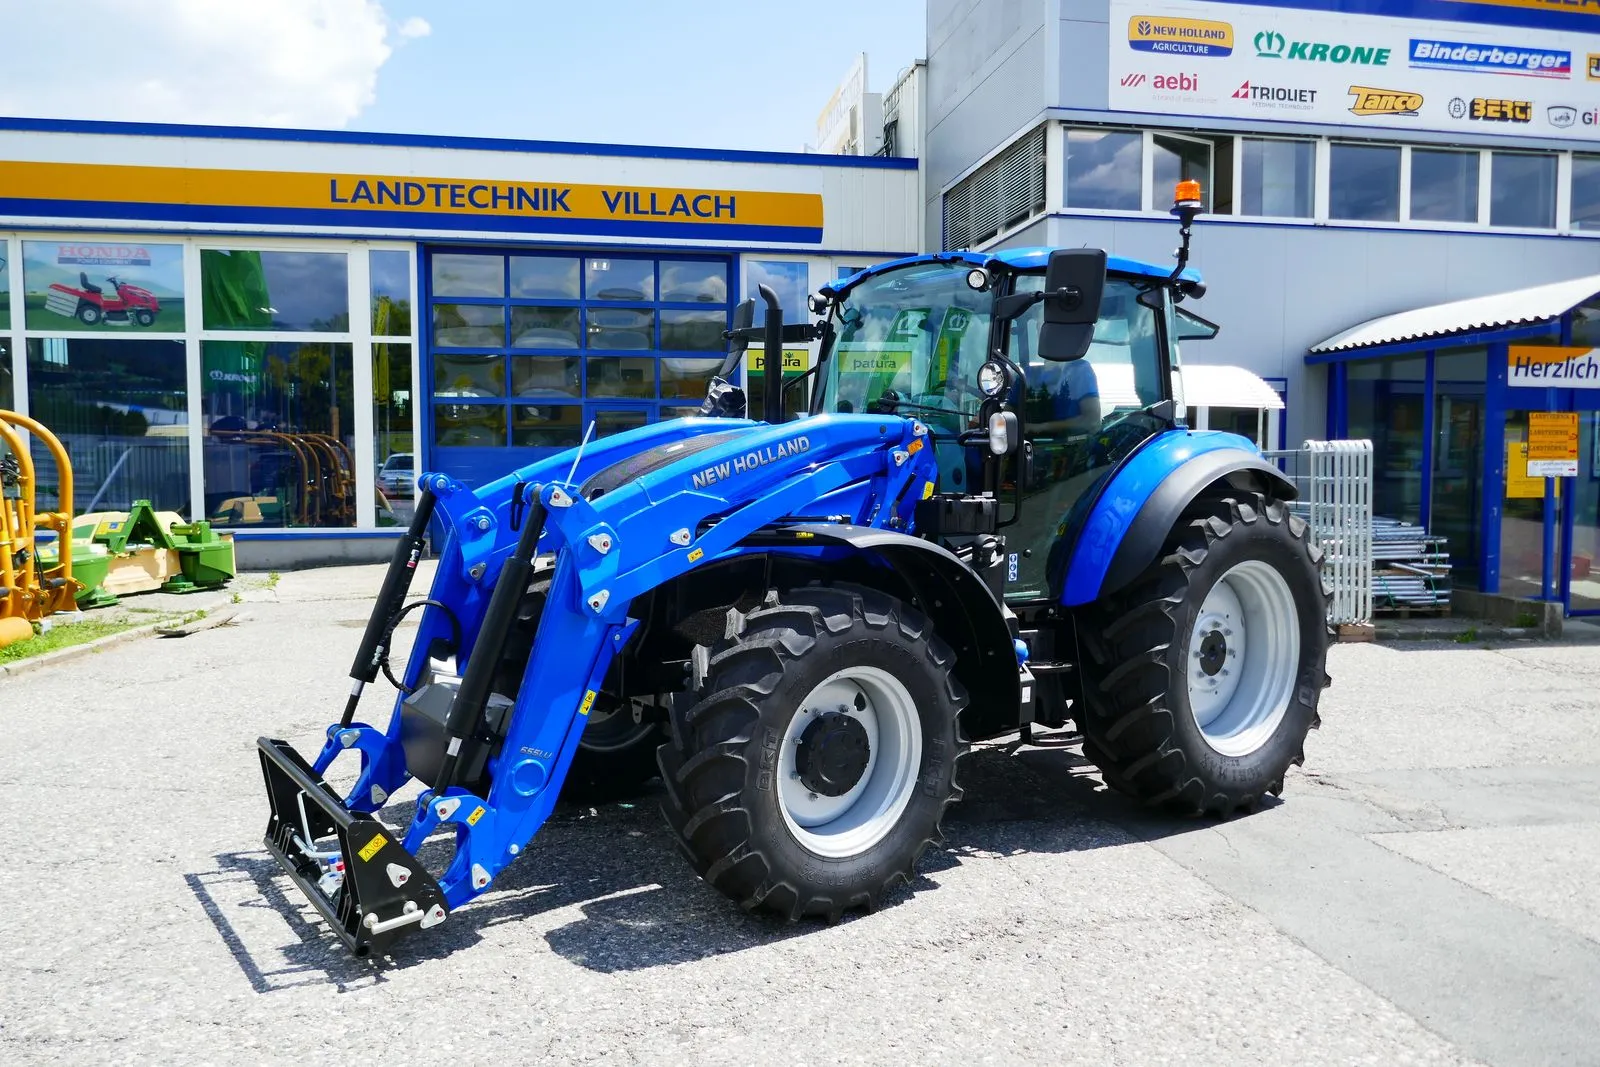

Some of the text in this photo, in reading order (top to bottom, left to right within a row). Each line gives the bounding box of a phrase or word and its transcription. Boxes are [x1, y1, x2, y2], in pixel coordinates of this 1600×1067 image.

[1153, 25, 1226, 40] NEW HOLLAND
[1152, 42, 1209, 54] AGRICULTURE
[1287, 41, 1391, 66] KRONE
[1413, 43, 1568, 69] Binderberger
[1153, 73, 1198, 91] aebi
[1250, 86, 1317, 103] TRIOLIET
[1348, 86, 1423, 114] Tanco
[329, 178, 737, 219] LANDTECHNIK VILLACH
[58, 245, 150, 259] HONDA
[853, 359, 897, 371] patura
[1514, 356, 1599, 380] Herzlich
[692, 436, 811, 490] NEW HOLLAND
